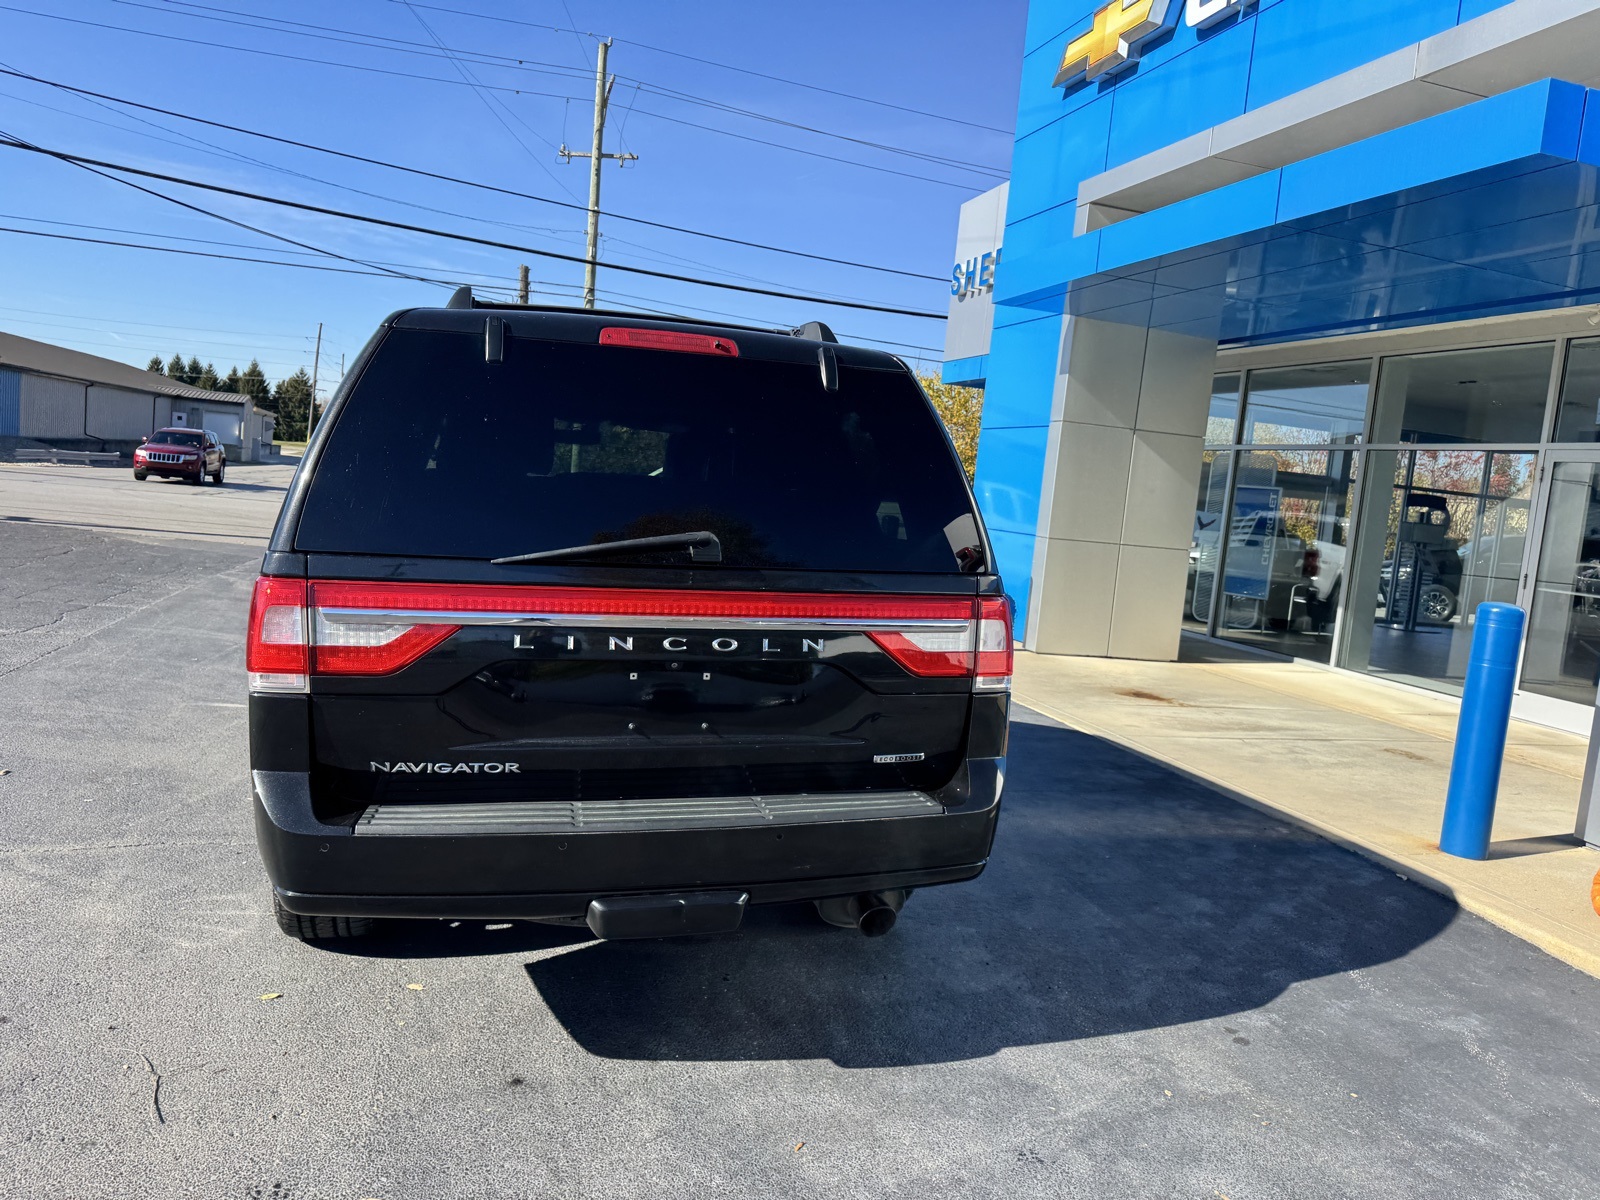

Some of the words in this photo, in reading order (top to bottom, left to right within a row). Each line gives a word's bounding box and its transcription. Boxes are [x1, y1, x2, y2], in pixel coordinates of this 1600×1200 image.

[951, 247, 1003, 296] SHE
[1261, 492, 1277, 566] CHEVROLET
[513, 634, 825, 653] LINCOLN
[370, 761, 521, 774] NAVIGATOR
